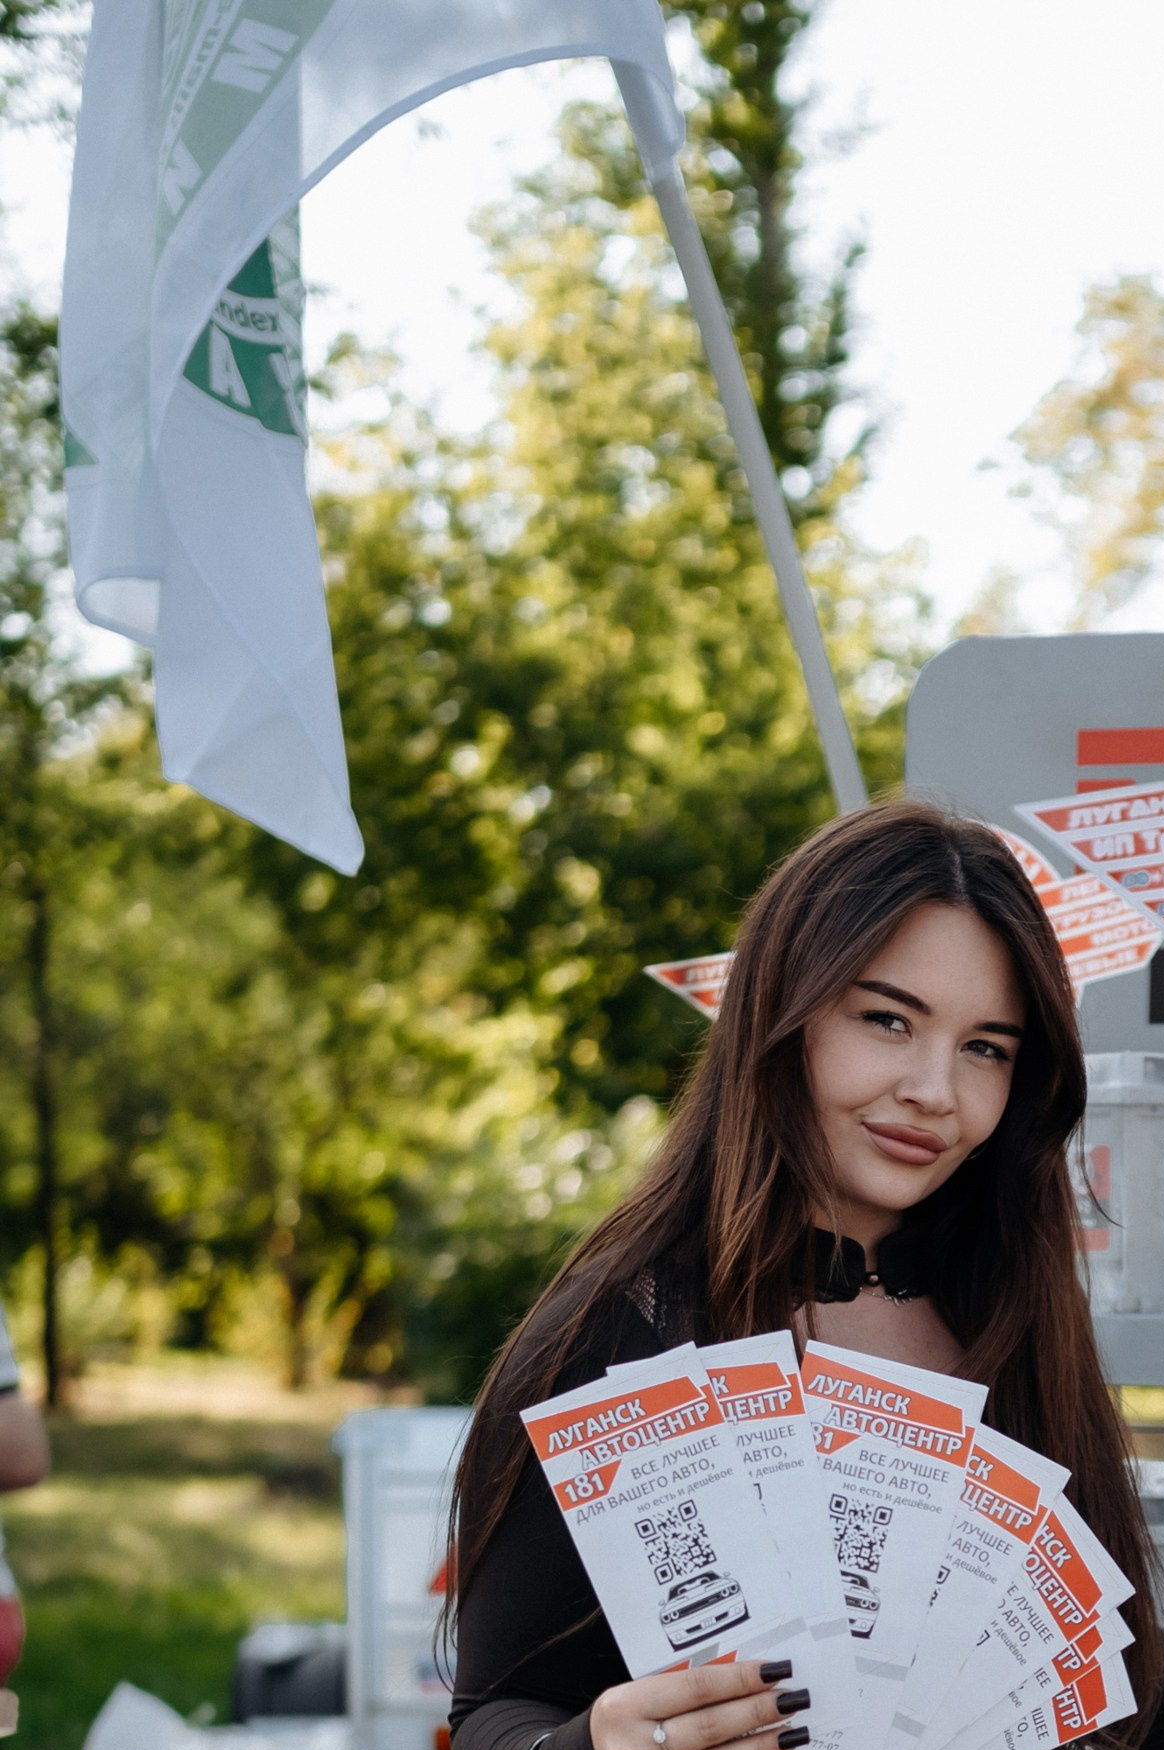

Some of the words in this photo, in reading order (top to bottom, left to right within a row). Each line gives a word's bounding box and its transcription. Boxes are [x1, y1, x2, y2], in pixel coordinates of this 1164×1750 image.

[1093, 833, 1135, 859] ИП
[717, 1390, 793, 1426] ЦЕНТР
[807, 1372, 911, 1415] ЛУГАНСК
[546, 1397, 646, 1453] ЛУГАНСК
[580, 1402, 711, 1471] АВТОЦЕНТР
[736, 1424, 797, 1447] ЛУЧШЕЕ
[812, 1422, 834, 1450] 81
[824, 1408, 963, 1455] АВТОЦЕНТР
[630, 1458, 659, 1481] ВСЕ
[661, 1434, 721, 1468] ЛУЧШЕЕ
[743, 1445, 788, 1464] АВТО,
[756, 1458, 805, 1479] дешёвое
[858, 1450, 887, 1470] ВСЕ
[888, 1456, 950, 1484] ЛУЧШЕЕ
[564, 1472, 606, 1503] 181
[574, 1501, 607, 1526] ДЛЯ
[608, 1475, 669, 1509] ВАШЕГО
[672, 1459, 716, 1489] АВТО,
[637, 1502, 652, 1514] но
[652, 1492, 677, 1510] есть
[677, 1487, 686, 1497] и
[686, 1467, 735, 1495] дешёвое
[822, 1456, 886, 1486] ВАШЕГО
[888, 1473, 932, 1499] АВТО,
[843, 1482, 857, 1493] но
[858, 1485, 884, 1499] есть
[893, 1492, 943, 1516] дешёвое
[962, 1484, 1033, 1531] ЦЕНТР
[952, 1537, 991, 1568] АВТО,
[957, 1518, 1014, 1556] ЛУЧШЕЕ
[955, 1556, 998, 1585] дешёвое
[1022, 1546, 1084, 1628] ОЦЕНТР
[1002, 1608, 1031, 1647] АВТО,
[1014, 1595, 1055, 1645] ЛУЧШЕЕ
